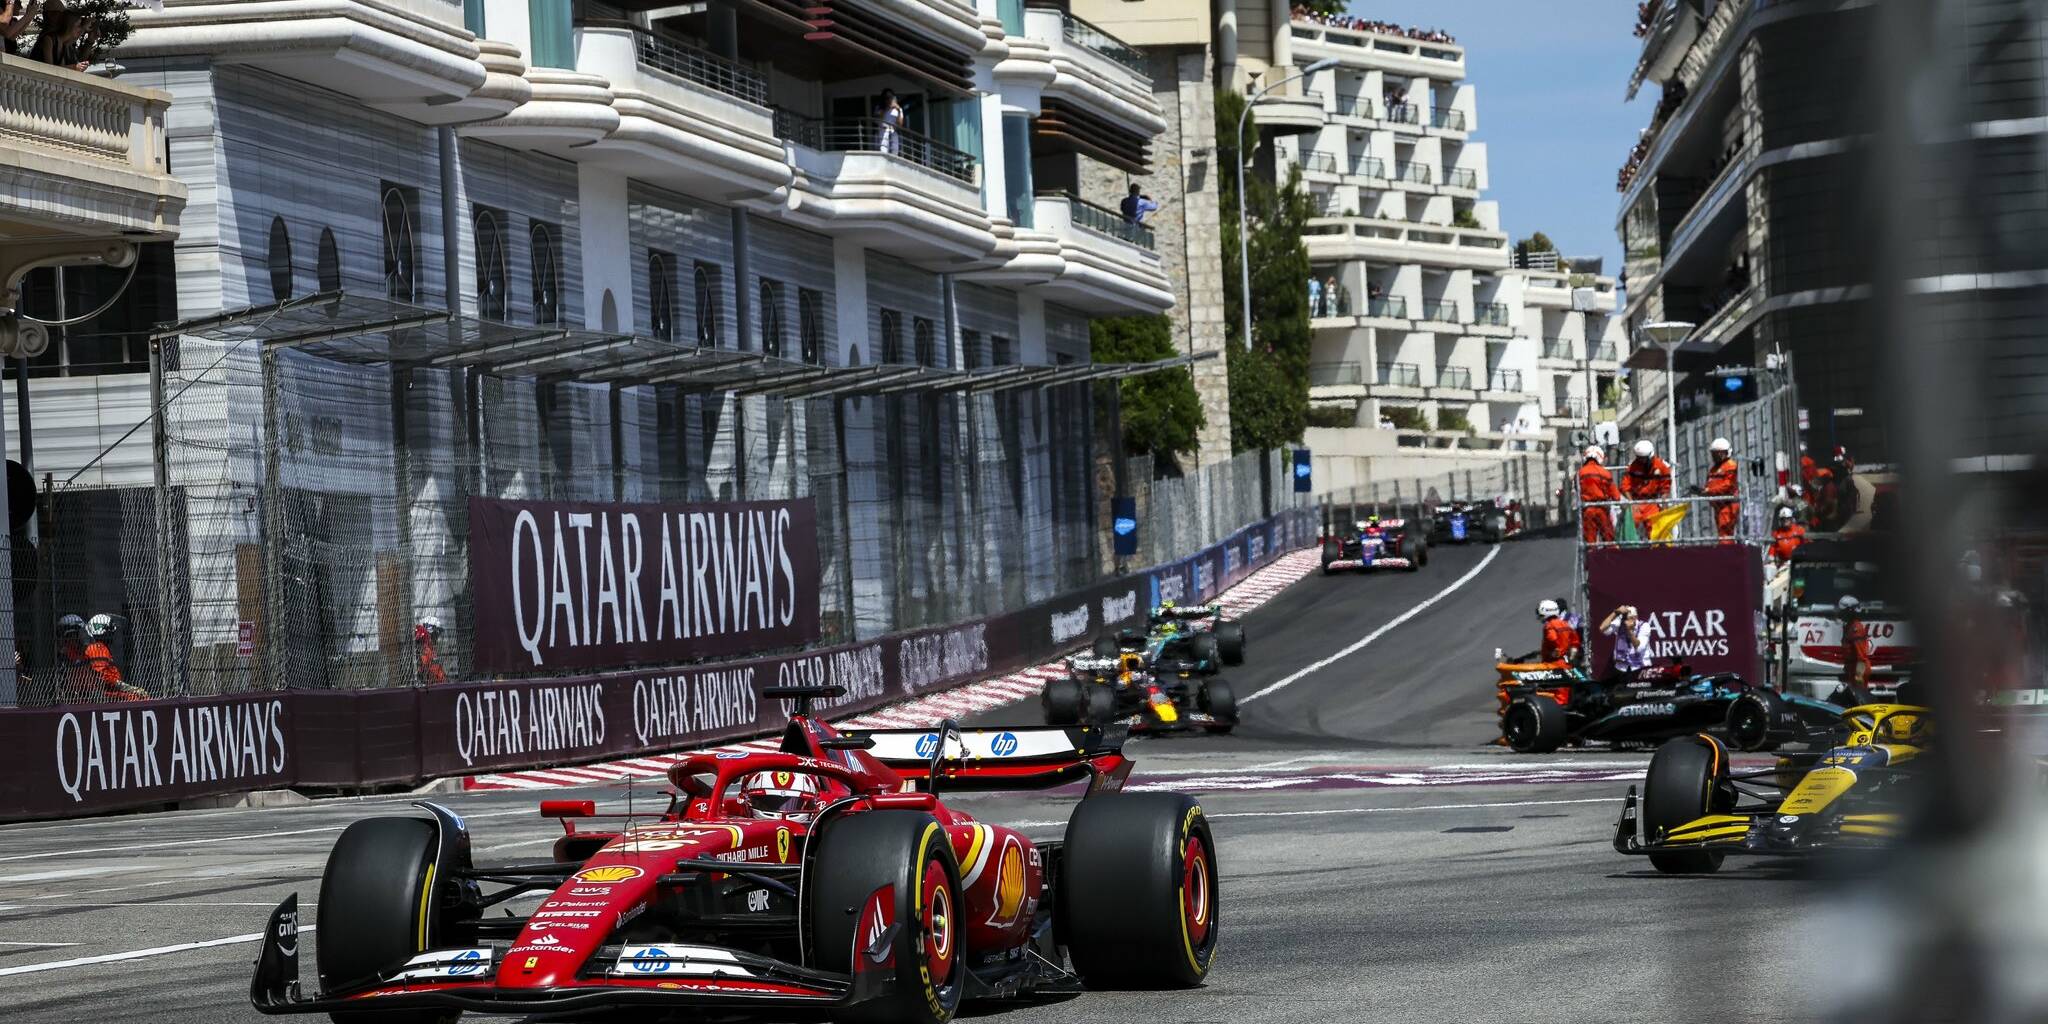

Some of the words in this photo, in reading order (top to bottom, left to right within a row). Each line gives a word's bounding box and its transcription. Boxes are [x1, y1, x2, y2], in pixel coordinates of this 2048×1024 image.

[512, 509, 648, 667] QATAR
[656, 507, 795, 642] AIRWAYS
[1649, 609, 1729, 639] ATAR
[456, 688, 524, 767] QATAR
[528, 682, 605, 752] AIRWAYS
[633, 675, 690, 746] QATAR
[692, 666, 756, 732] AIRWAYS
[56, 709, 163, 803] QATAR
[169, 700, 286, 785] AIRWAYS
[994, 732, 1016, 757] hp
[747, 845, 769, 860] MILLE
[570, 886, 613, 894] aws
